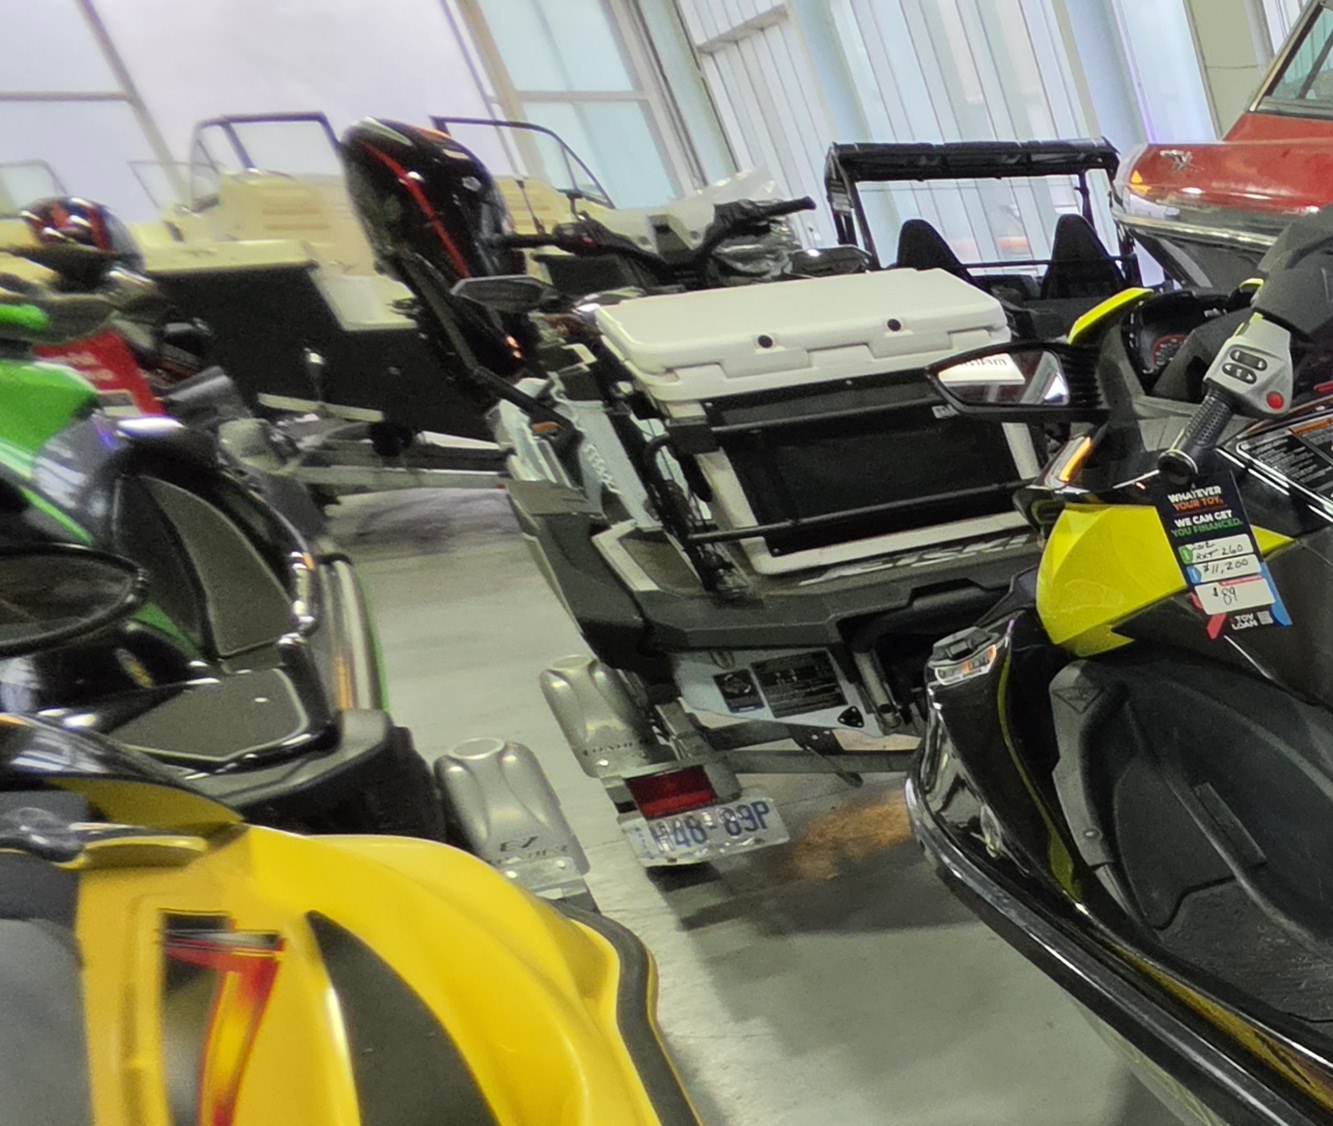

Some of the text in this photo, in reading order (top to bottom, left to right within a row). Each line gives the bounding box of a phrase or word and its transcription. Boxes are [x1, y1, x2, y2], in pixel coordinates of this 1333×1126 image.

[1167, 485, 1222, 503] WHATEVER
[1173, 500, 1201, 512] YOUR
[1174, 509, 1233, 528] WE CAN GET
[1171, 526, 1193, 538] YOU
[1221, 544, 1244, 556] 260
